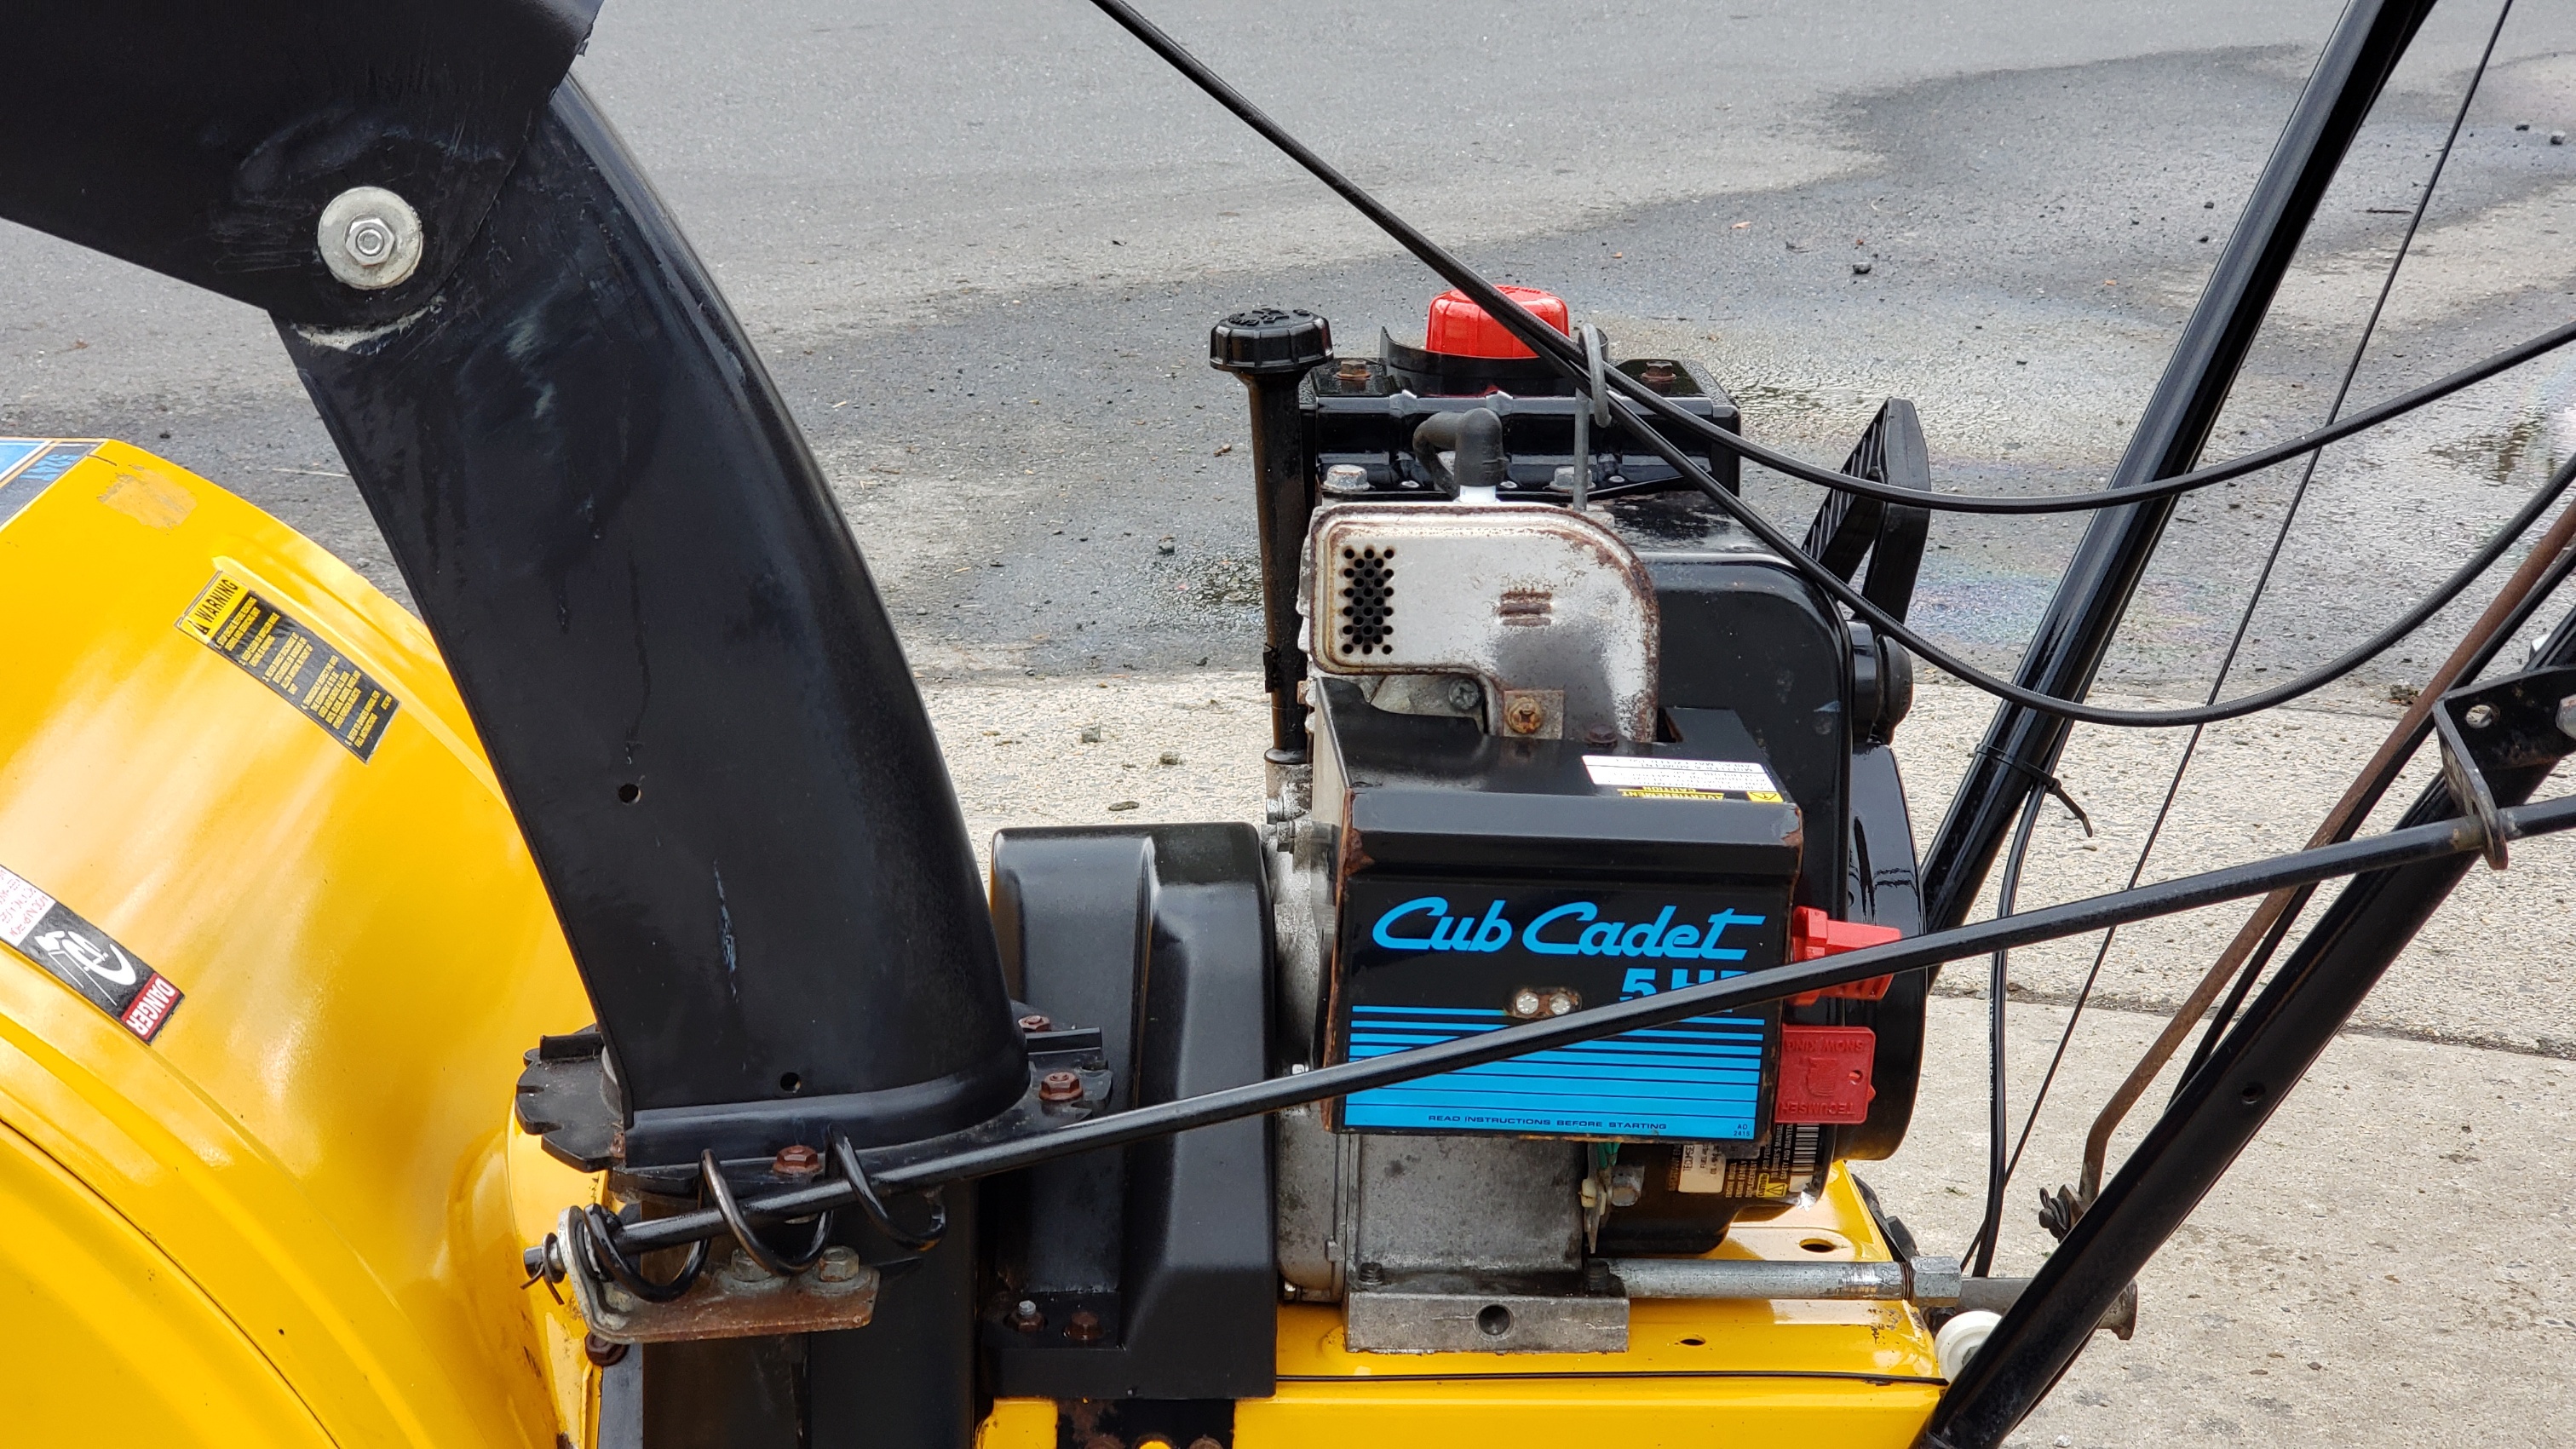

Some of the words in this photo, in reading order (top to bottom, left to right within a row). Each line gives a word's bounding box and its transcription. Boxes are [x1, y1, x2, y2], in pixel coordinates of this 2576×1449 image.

[194, 578, 239, 624] WARNING
[1372, 896, 1513, 952] Cub
[1522, 901, 1766, 961] Cadet
[1619, 968, 1657, 1002] 5
[126, 977, 175, 1037] DANGER
[1821, 1038, 1865, 1053] SNOW
[1464, 1116, 1551, 1126] INSTRUCTIONS
[1556, 1119, 1602, 1128] BEFORE
[1608, 1121, 1667, 1130] STARTING
[1779, 1102, 1856, 1115] TECUMSEH
[1774, 1124, 1784, 1147] MANUAL
[1682, 1145, 1694, 1171] TECUMSE
[1780, 1161, 1788, 1179] SAFETY
[1784, 1123, 1793, 1148] MAINTEN
[1738, 1159, 1747, 1180] FAMILY
[1745, 1160, 1757, 1197] DISPLACEMENT
